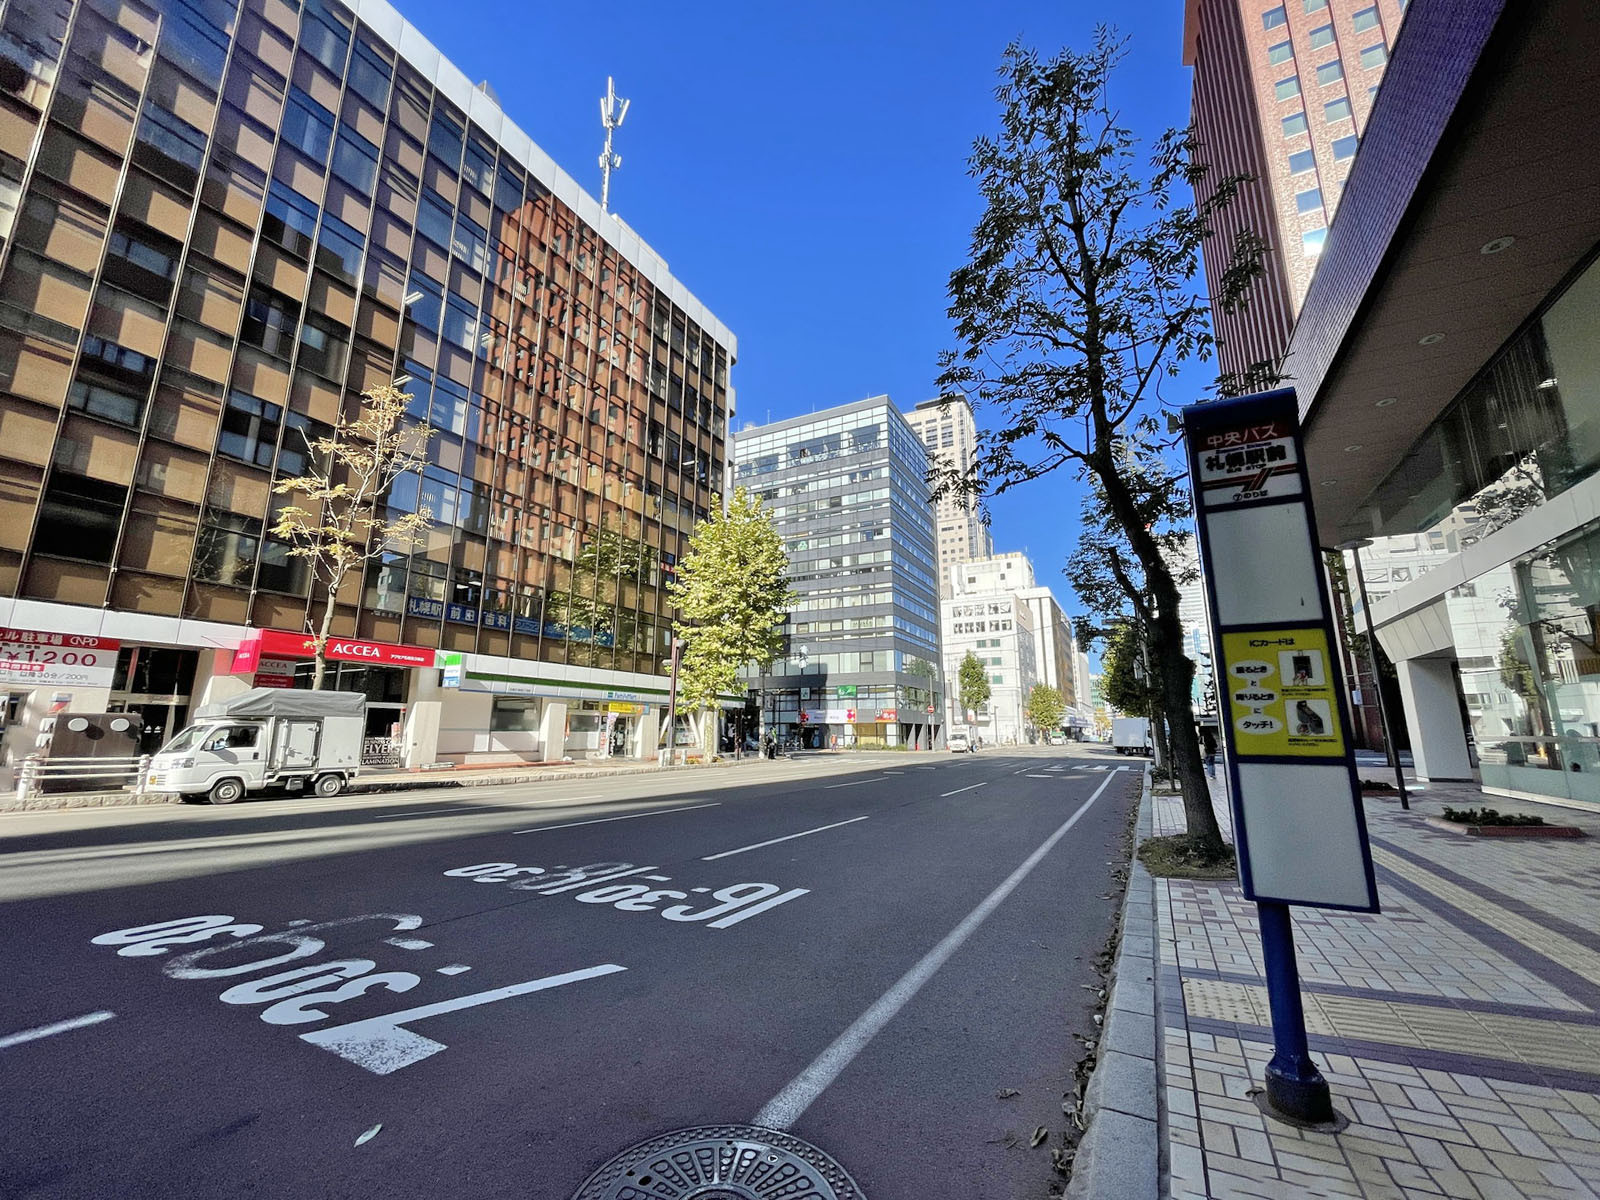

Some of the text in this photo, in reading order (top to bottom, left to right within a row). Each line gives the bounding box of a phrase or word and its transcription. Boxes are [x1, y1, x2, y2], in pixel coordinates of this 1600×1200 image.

[1207, 423, 1278, 448] 中央バス
[332, 643, 381, 658] ACCEA
